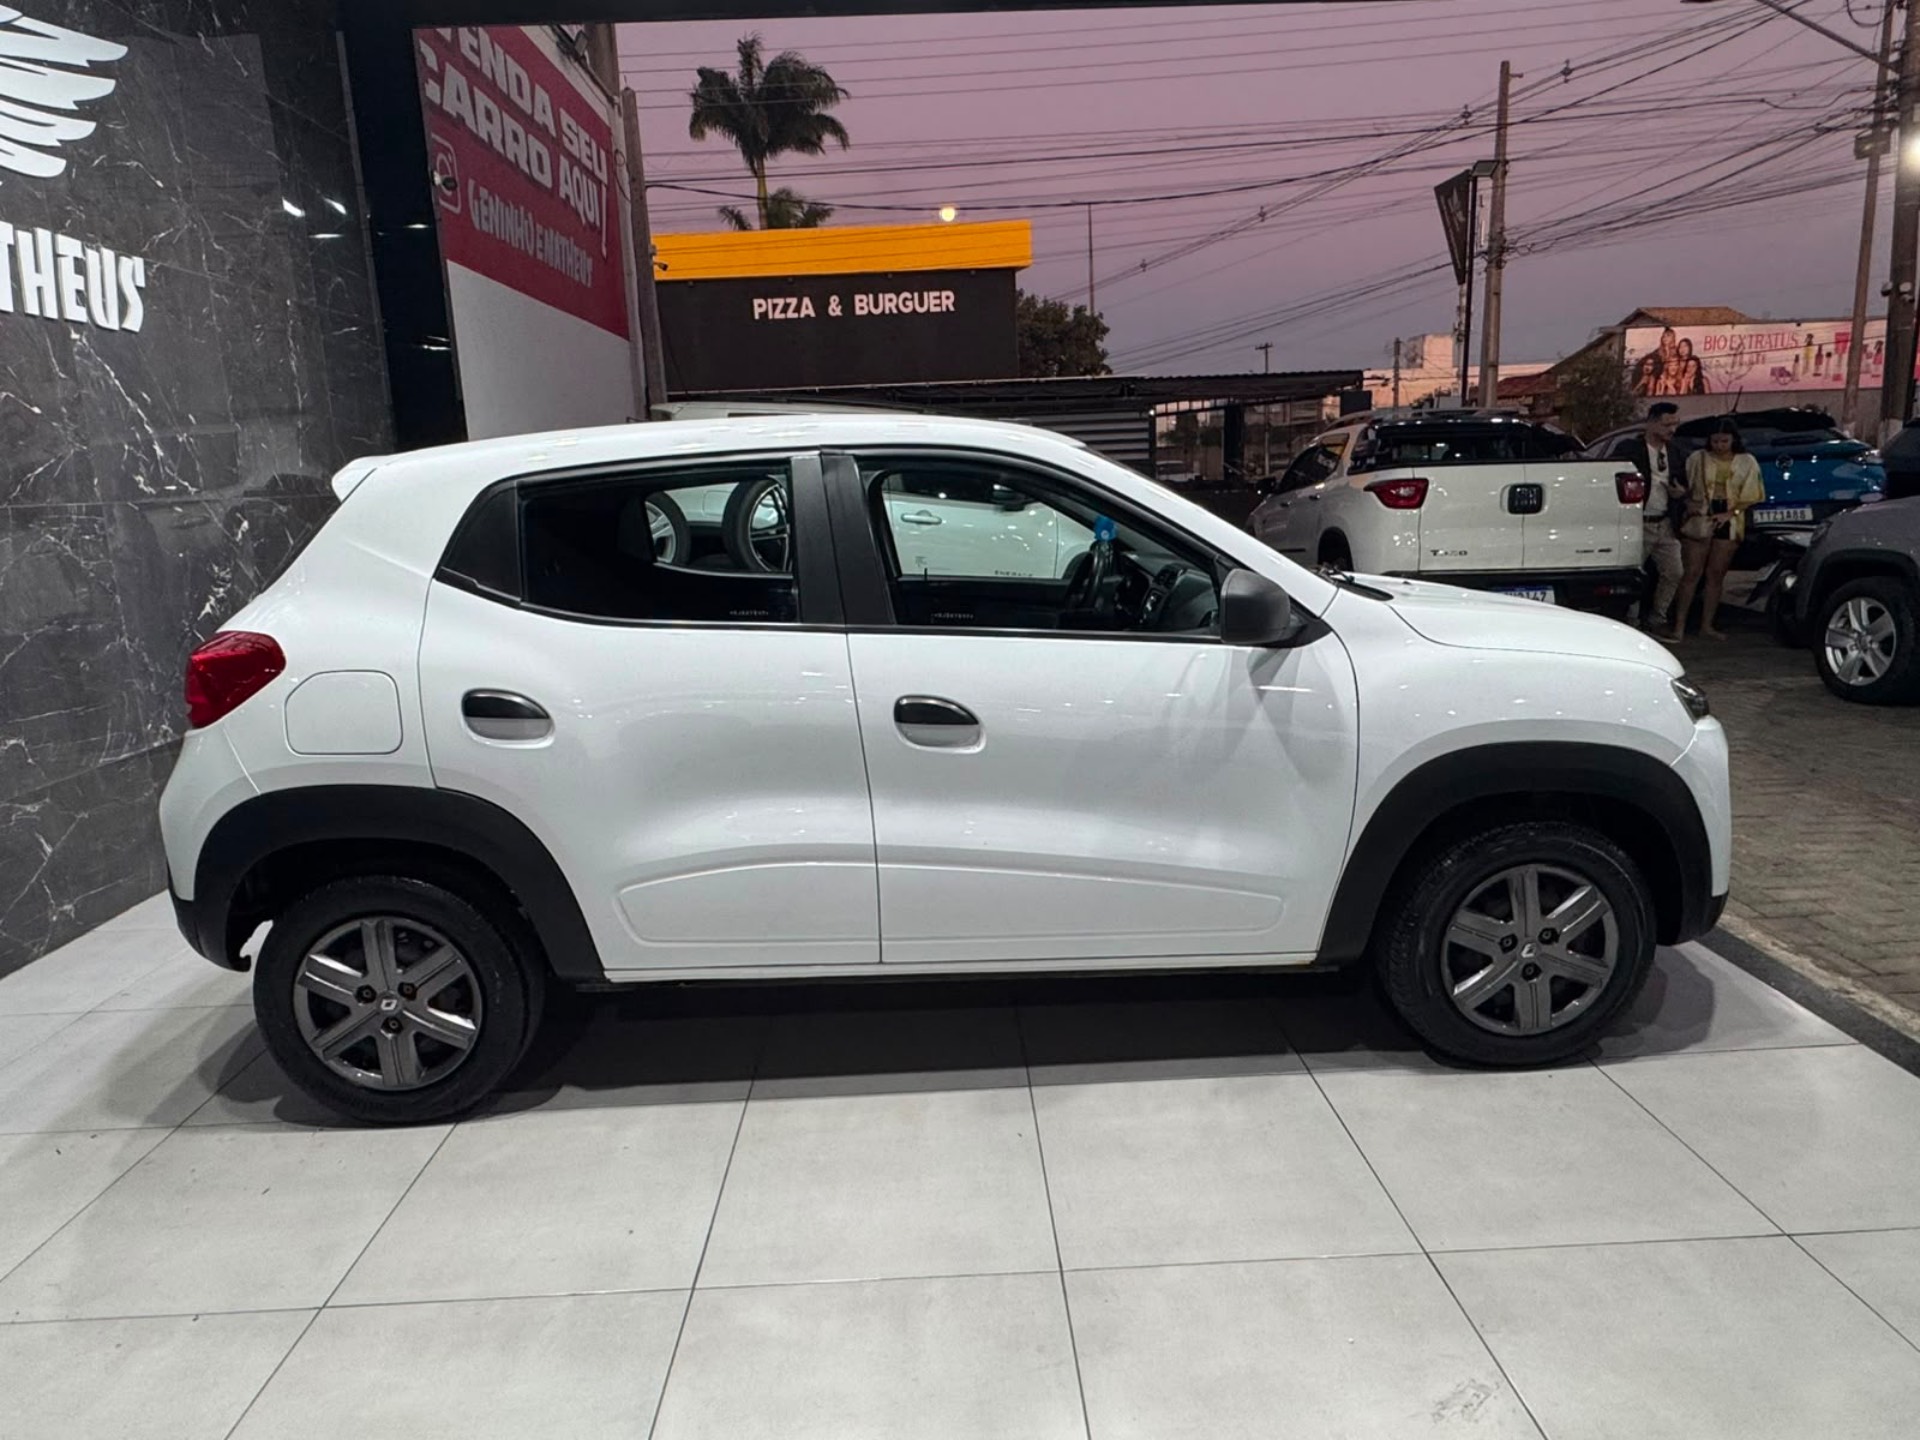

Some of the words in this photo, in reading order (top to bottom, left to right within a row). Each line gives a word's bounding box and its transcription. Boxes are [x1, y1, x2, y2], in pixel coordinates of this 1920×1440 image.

[559, 106, 608, 188] SEU
[753, 297, 816, 320] PIZZA
[828, 295, 843, 316] &
[854, 291, 955, 316] BURGUER
